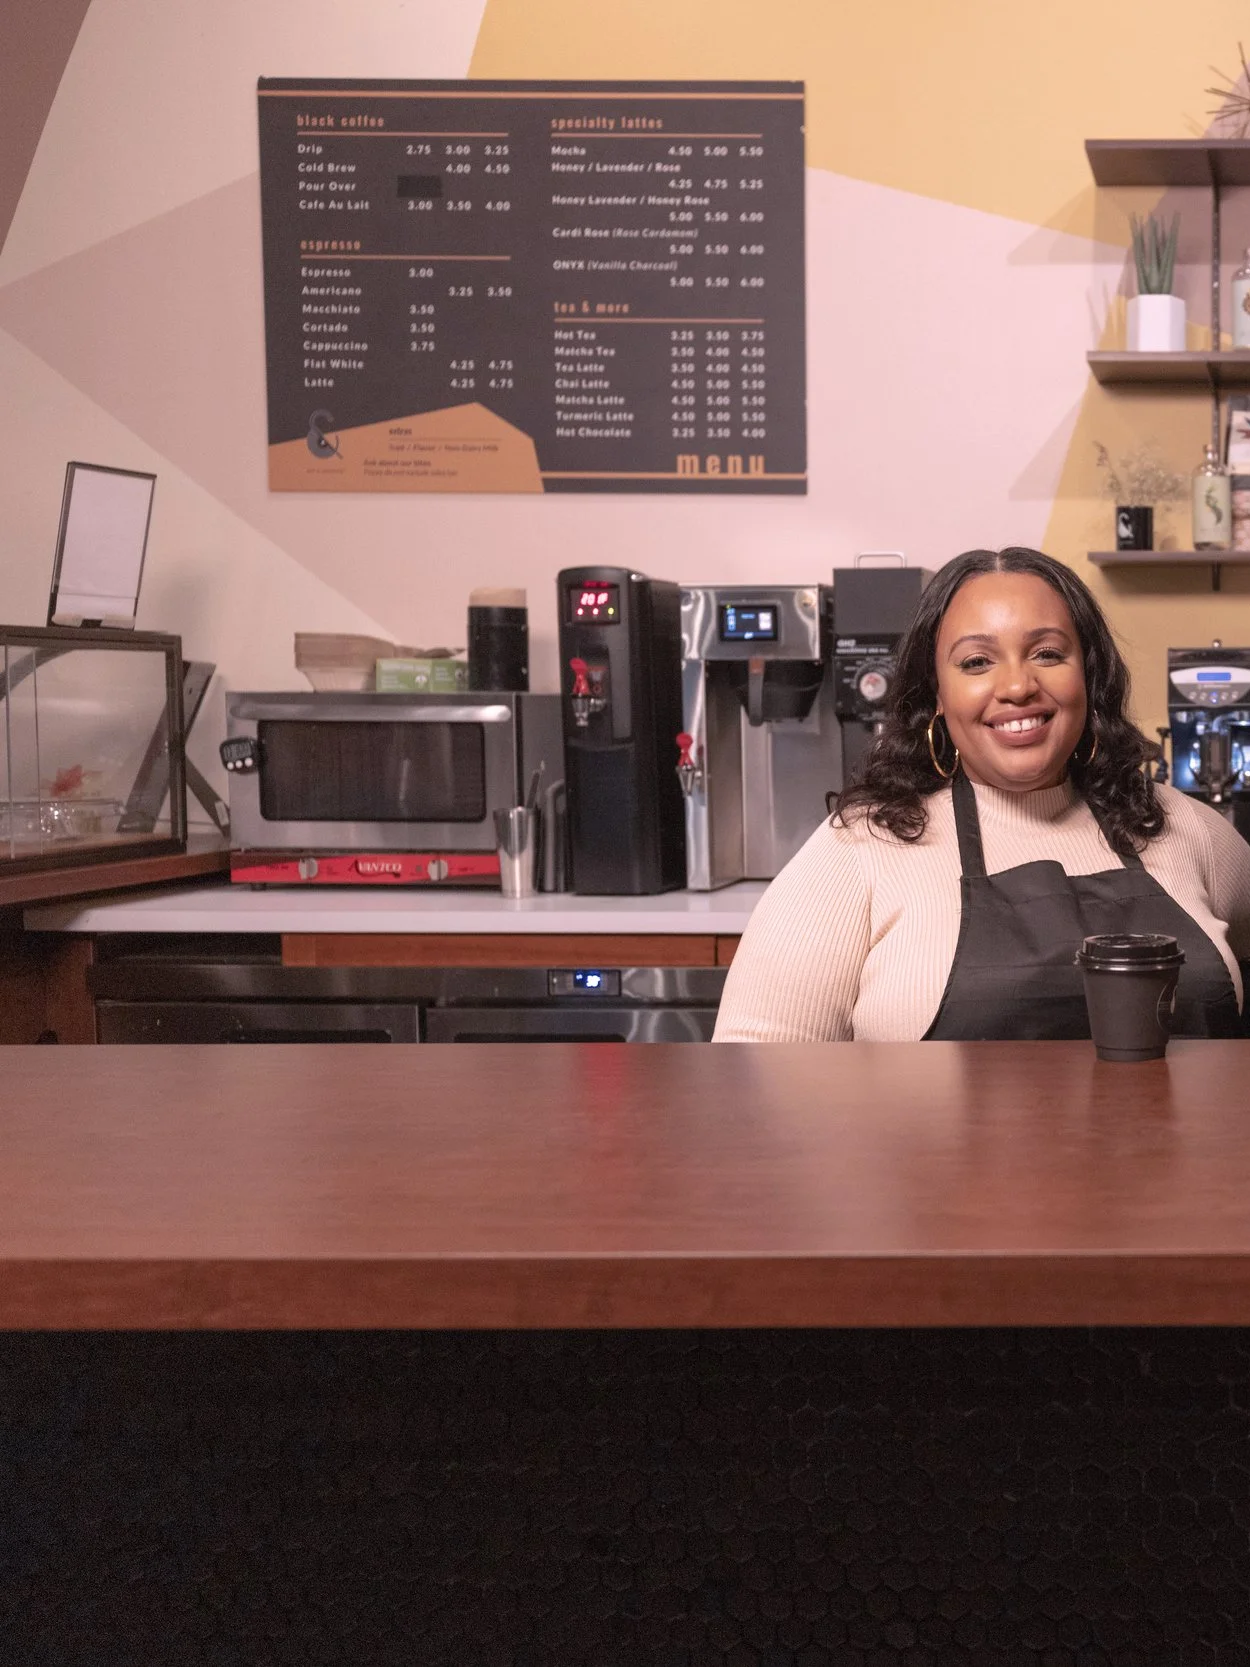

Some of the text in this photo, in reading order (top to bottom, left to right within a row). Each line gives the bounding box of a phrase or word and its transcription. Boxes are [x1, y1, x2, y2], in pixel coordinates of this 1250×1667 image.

[296, 114, 385, 128] black coffee
[550, 116, 663, 130] specialty lattes
[297, 143, 323, 155] Drip
[550, 145, 587, 156] Mocha
[297, 162, 324, 173] Cold
[327, 162, 356, 173] Brew
[551, 162, 586, 173] Honey
[595, 162, 645, 173] Lavender
[654, 162, 681, 173] Rose
[298, 180, 356, 192] Pour Over
[298, 199, 325, 210] Cafe
[328, 199, 344, 210] Au
[551, 195, 586, 206] Honey
[587, 195, 637, 205] Lavender
[647, 195, 682, 206] Honey
[683, 195, 710, 206] Rose
[551, 227, 582, 238] Cardi
[583, 227, 610, 238] Rose
[300, 240, 361, 252] espresso
[552, 259, 585, 270] ONYX
[300, 266, 352, 278] Espresso
[301, 285, 362, 296] Americano
[301, 303, 361, 314] Macchiato
[553, 300, 630, 314] tea & more
[302, 322, 349, 333] Cortado
[553, 330, 574, 340] Hot
[576, 329, 597, 341] Tea
[302, 340, 369, 352] Cappuccino
[554, 346, 594, 357] Matcha
[595, 346, 616, 357] Tea
[303, 358, 327, 369] Flat
[329, 359, 364, 369] White
[554, 361, 575, 373] Tea
[576, 362, 605, 373] Latte
[304, 377, 334, 388] Latte
[554, 378, 580, 389] Chai
[581, 379, 610, 389] Latte
[555, 394, 595, 405] Matcha
[596, 395, 625, 405] Latte
[555, 410, 604, 422] Turmeric
[605, 411, 635, 422] Latte
[555, 427, 576, 437] Hot
[577, 426, 632, 438] Chocolate
[677, 455, 765, 475] menu
